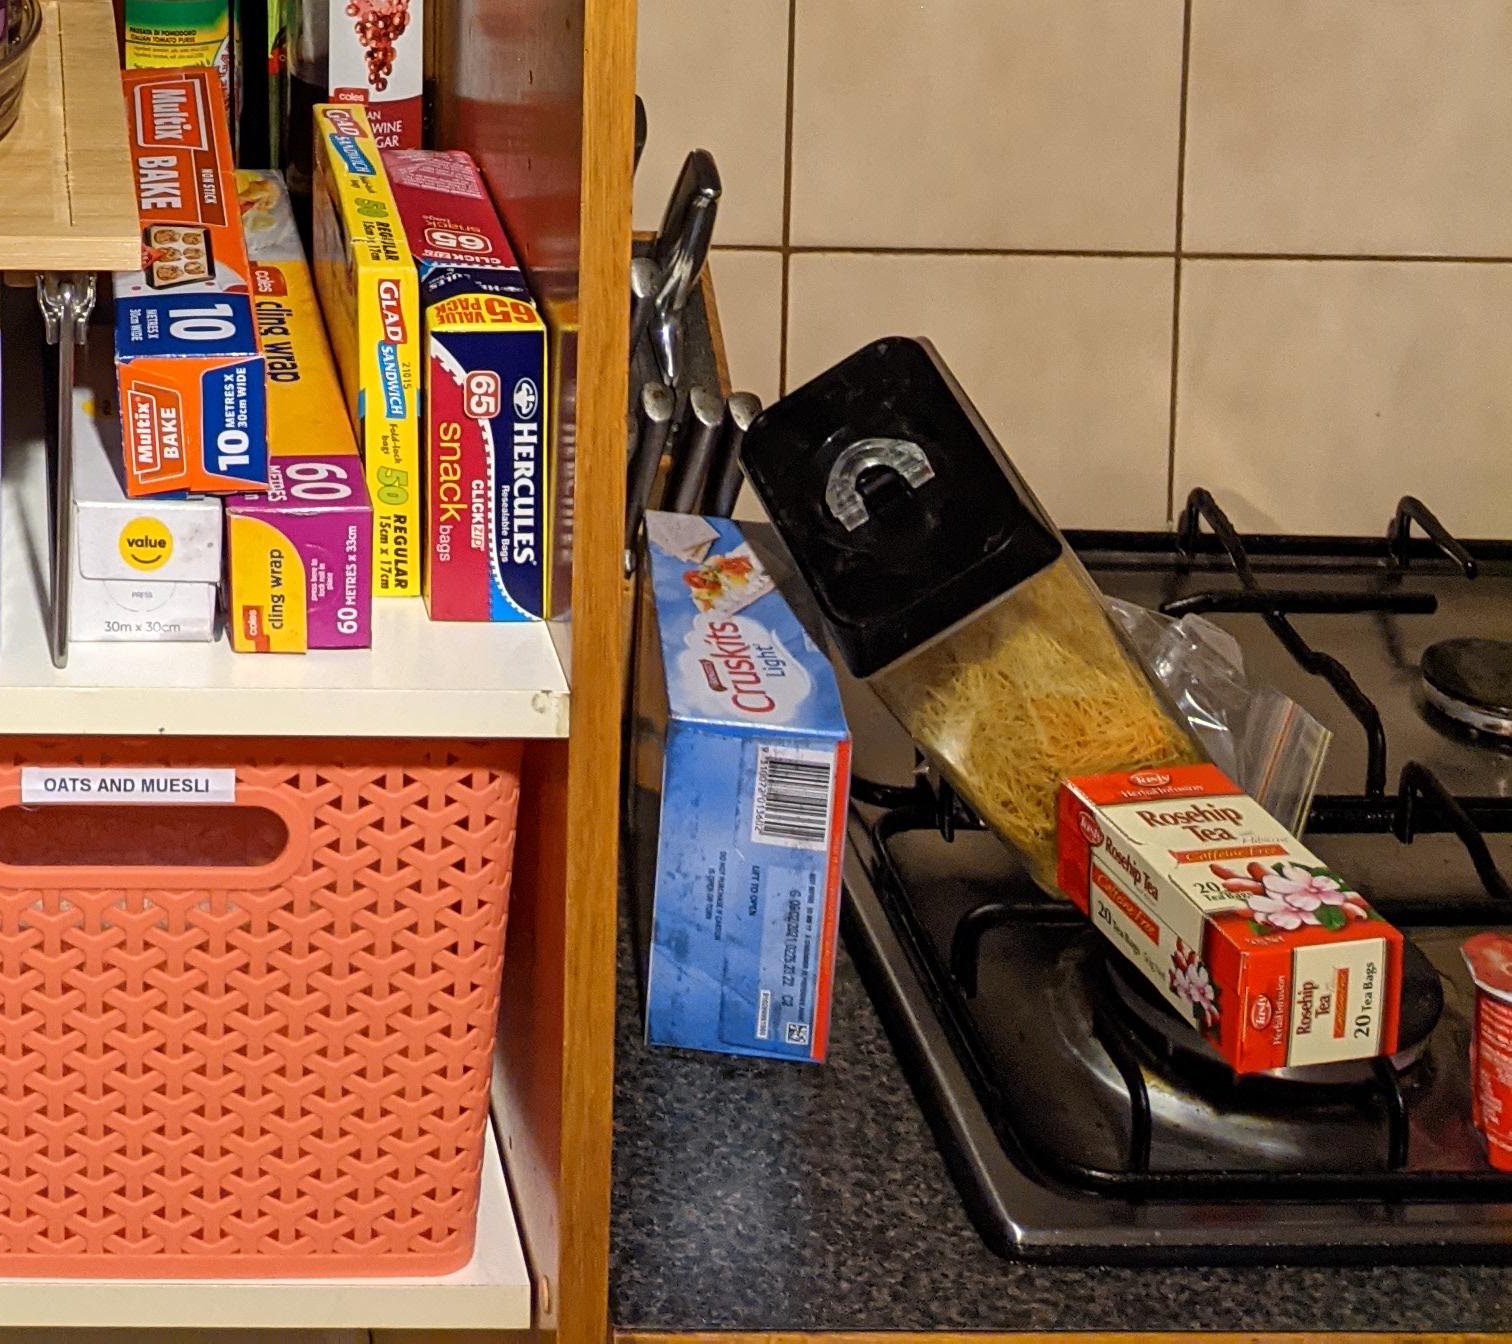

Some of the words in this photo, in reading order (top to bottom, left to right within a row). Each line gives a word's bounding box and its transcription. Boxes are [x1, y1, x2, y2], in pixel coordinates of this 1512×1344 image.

[339, 93, 364, 102] coles
[152, 89, 192, 140] Multix
[372, 121, 402, 133] WINE
[376, 136, 399, 148] GAR
[138, 156, 182, 209] BAKE
[255, 270, 272, 293] coles
[255, 301, 293, 336] cling
[379, 281, 403, 342] GLAD
[434, 298, 481, 312] PACK
[436, 312, 485, 324] VALUE
[485, 298, 537, 323] 65
[169, 303, 236, 341] 10
[265, 341, 300, 382] wrap
[224, 374, 234, 382] X
[236, 368, 247, 396] WIDE
[380, 345, 403, 417] SANDWICH
[224, 384, 236, 428] METRES
[470, 375, 496, 414] 65
[238, 400, 248, 428] 30cm
[136, 403, 153, 463] Multix
[161, 407, 179, 459] BAKE
[218, 430, 250, 472] 10
[286, 462, 352, 501] 60
[377, 466, 409, 506] 50
[439, 422, 468, 522] snack
[513, 422, 538, 564] HERCULES
[501, 485, 510, 537] Resealable
[127, 535, 166, 549] value
[346, 526, 357, 551] 33cm
[379, 515, 388, 544] 15cm
[348, 553, 357, 561] x
[381, 547, 388, 555] x
[394, 514, 408, 589] REGULAR
[439, 526, 453, 562] bags
[501, 537, 509, 562] Bags
[270, 549, 284, 587] wrap
[380, 560, 389, 589] 17cm
[345, 563, 357, 605] METRES
[249, 610, 258, 636] coles
[267, 593, 284, 629] cling
[338, 607, 357, 634] 60
[105, 621, 131, 633] 30m
[146, 621, 180, 633] 30cm
[704, 621, 776, 713] Cruskits
[753, 643, 787, 678] Light
[44, 778, 91, 793] OATS
[97, 778, 135, 793] AND
[140, 778, 209, 793] MUESLI
[1136, 804, 1243, 827] Rosehip
[1182, 825, 1238, 843] Tea
[1186, 849, 1247, 862] Caffeine
[1250, 846, 1277, 857] Free
[751, 865, 760, 881] LIFT
[1105, 835, 1142, 887] Rosehip
[1143, 872, 1158, 902] Tea
[750, 884, 759, 892] TO
[1194, 882, 1221, 894] 20
[748, 895, 758, 916] OPEN
[1363, 962, 1377, 990] Bags
[1296, 980, 1318, 1035] Rosehip
[1315, 994, 1331, 1019] Tea
[1361, 992, 1373, 1012] Tea
[1354, 1015, 1371, 1038] 20
